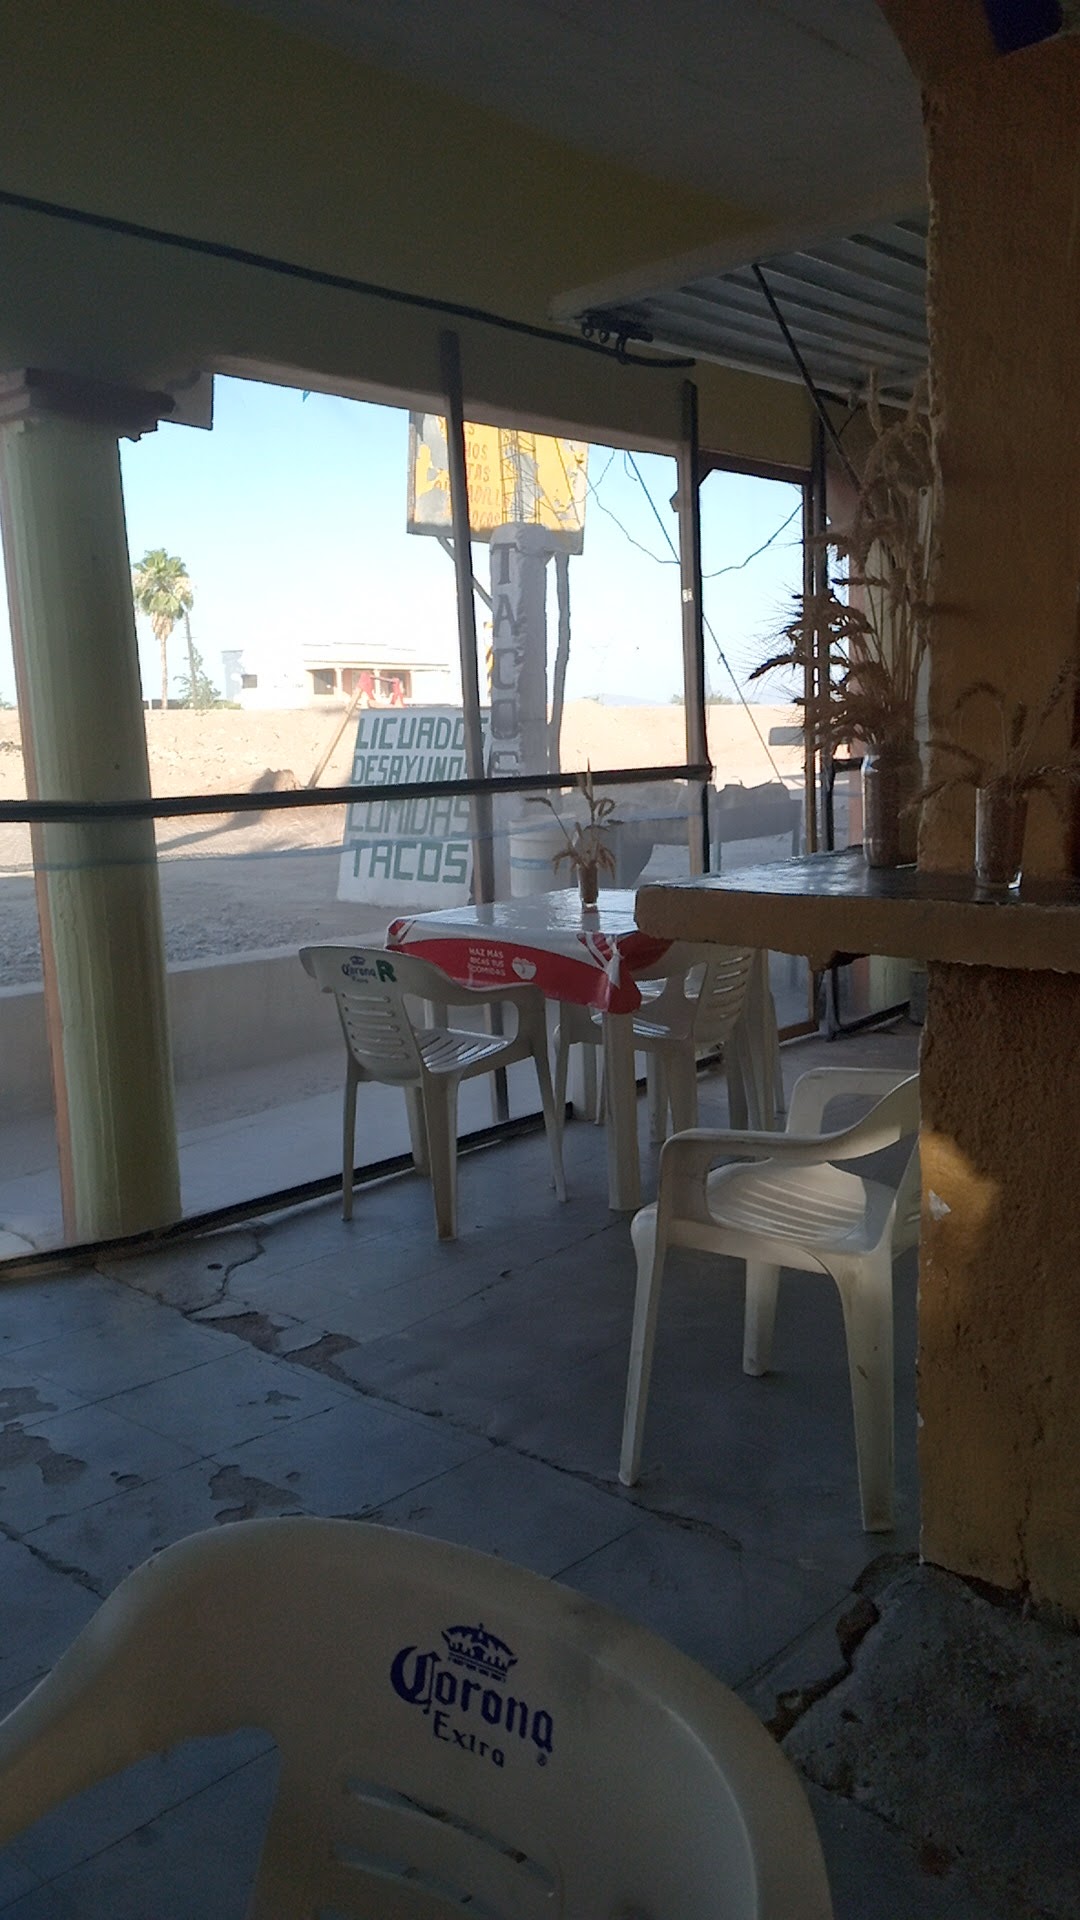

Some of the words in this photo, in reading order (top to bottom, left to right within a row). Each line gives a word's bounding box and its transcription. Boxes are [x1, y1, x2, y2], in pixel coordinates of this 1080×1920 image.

[350, 755, 467, 784] DESAYUNO
[347, 796, 470, 837] COMIDAS
[350, 839, 469, 885] TACOS
[390, 1645, 553, 1753] Corona
[433, 1709, 505, 1768] Extra
